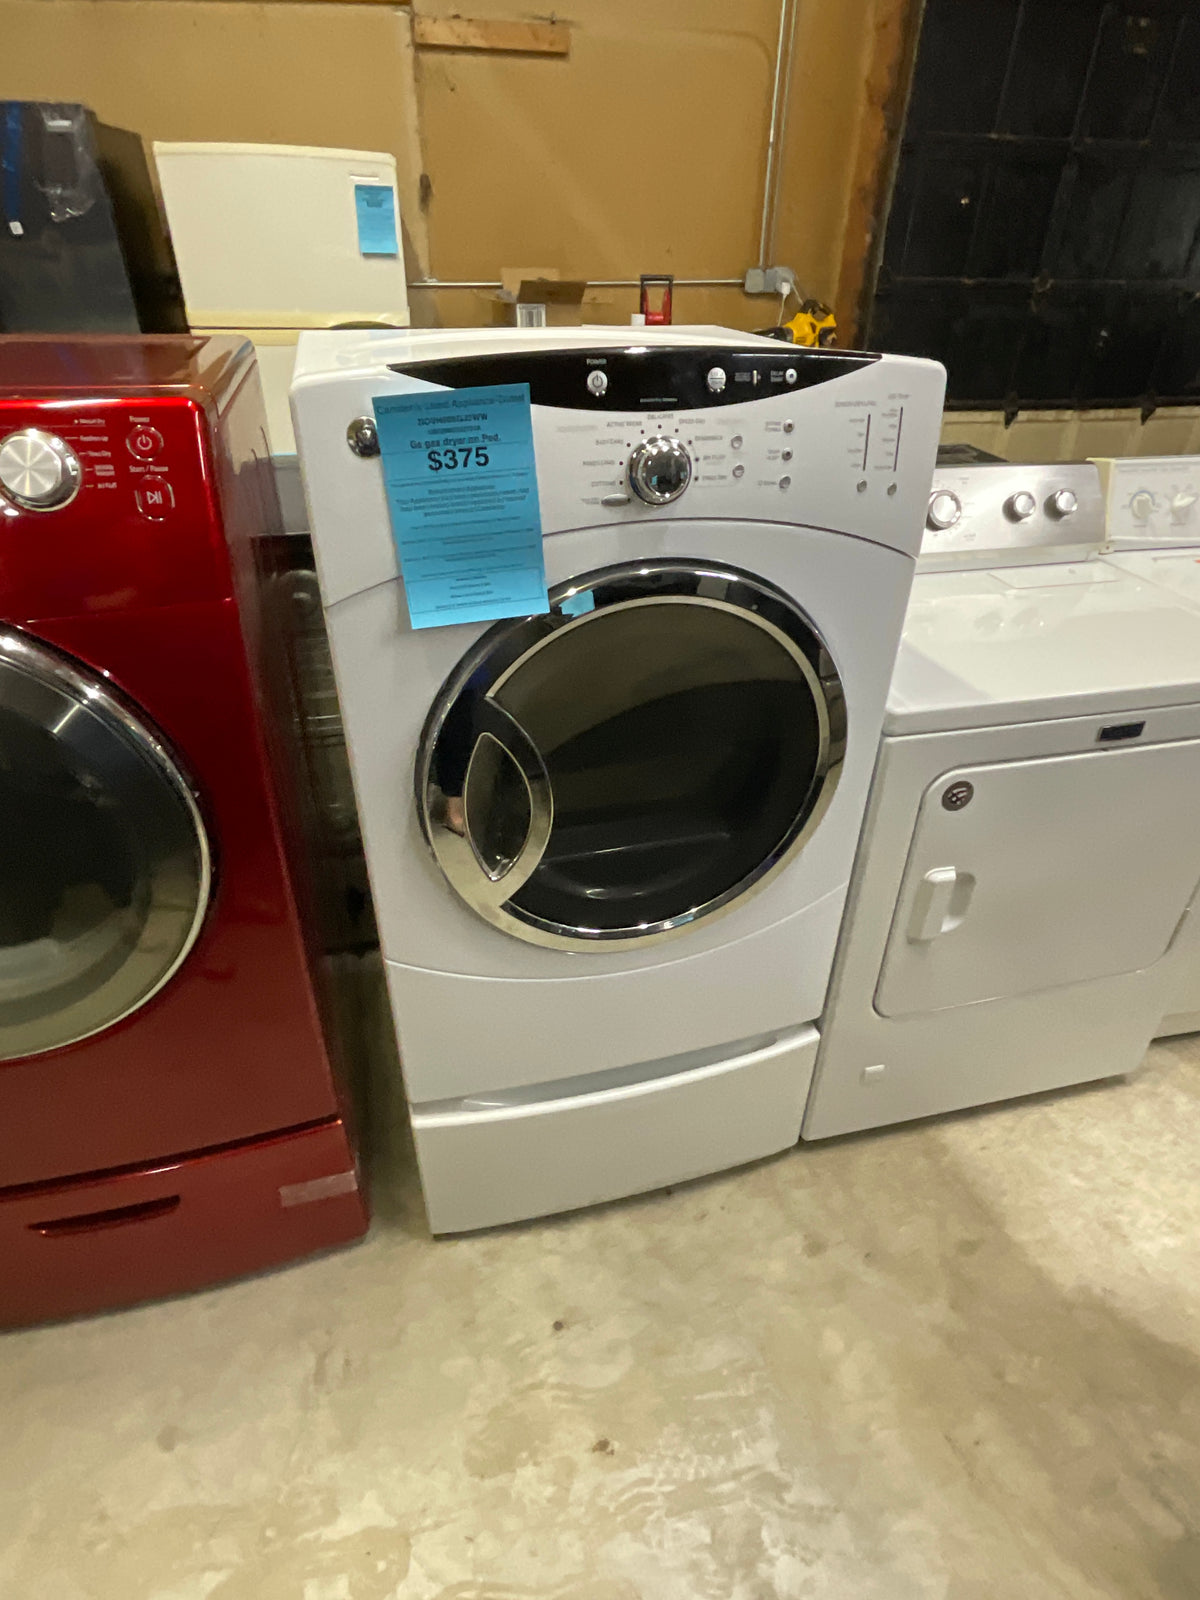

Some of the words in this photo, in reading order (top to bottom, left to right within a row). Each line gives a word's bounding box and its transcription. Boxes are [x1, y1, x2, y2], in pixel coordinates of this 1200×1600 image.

[424, 440, 441, 449] gas
[443, 437, 466, 447] dryer
[427, 446, 490, 474] $375
